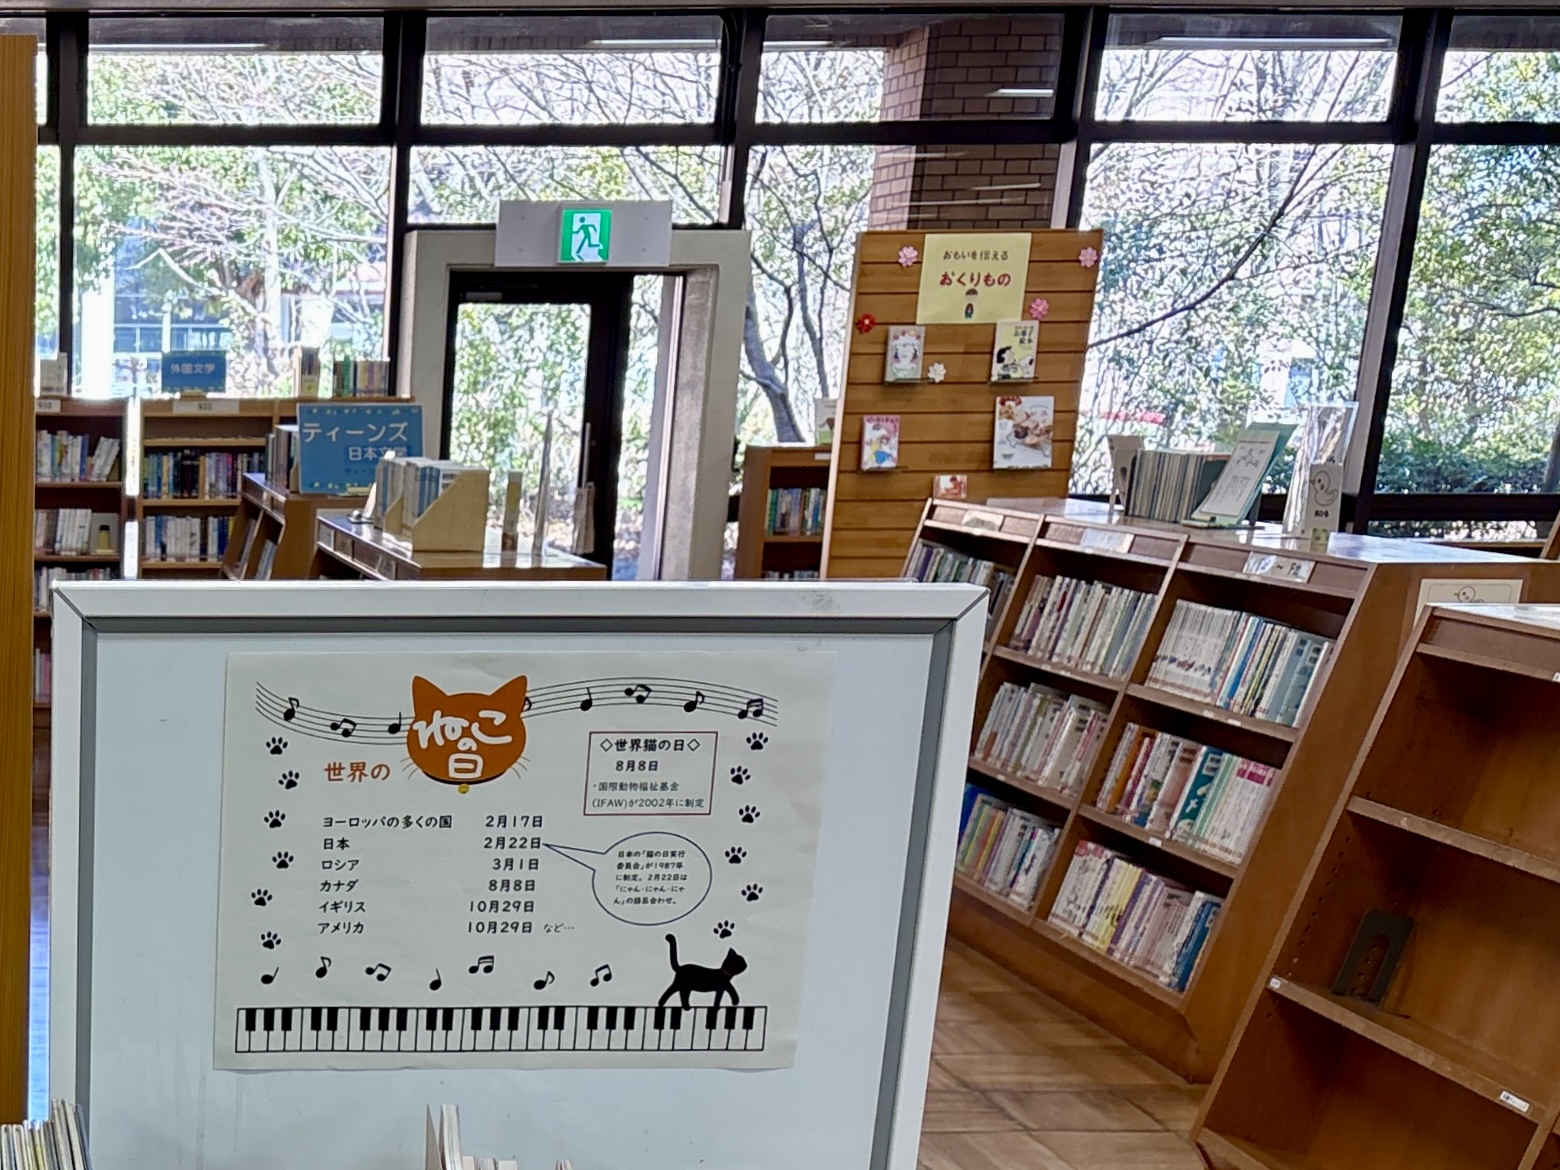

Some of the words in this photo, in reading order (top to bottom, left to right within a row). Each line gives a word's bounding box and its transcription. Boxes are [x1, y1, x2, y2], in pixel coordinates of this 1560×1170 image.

[940, 272, 1012, 287] おくりもの
[302, 422, 408, 443] ティーンズ
[412, 710, 513, 749] ねこ
[615, 759, 659, 772] 8月8日
[324, 762, 391, 784] 世界の
[322, 815, 453, 830] ヨーロッパの多くの国
[484, 815, 544, 830] 2月17日
[322, 836, 350, 850] 日本
[484, 836, 542, 850] 2月22日
[321, 858, 360, 872] ロシア
[492, 858, 540, 872] 3月1日
[319, 879, 359, 893] カナダ
[488, 879, 536, 893] 8月8日
[318, 900, 366, 914] イギリス
[468, 900, 535, 914] 10月29日
[318, 921, 364, 934] アメリカ
[466, 921, 533, 935] 10月29日
